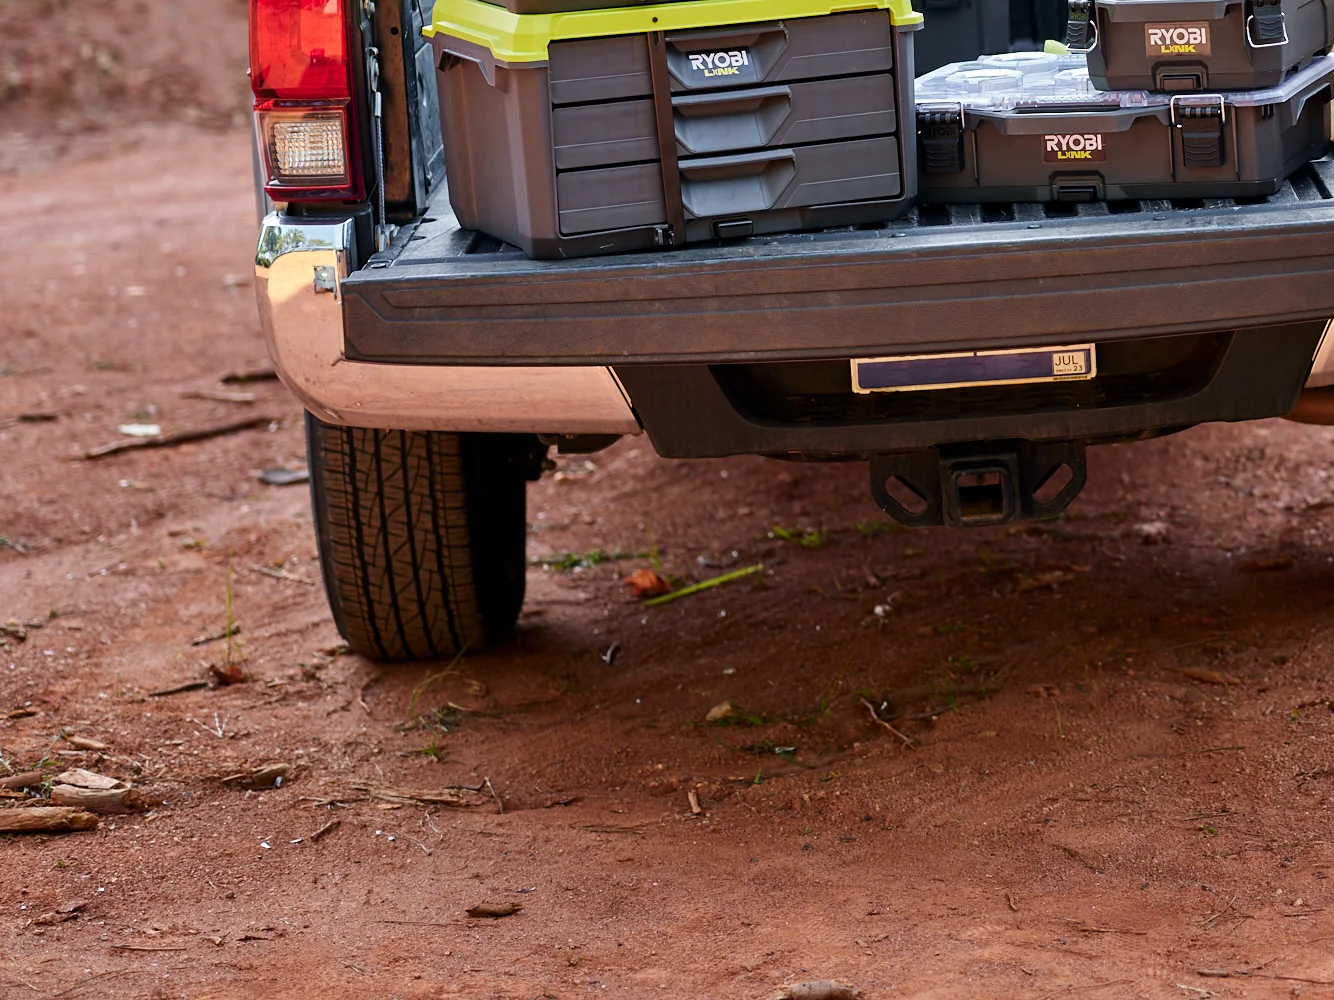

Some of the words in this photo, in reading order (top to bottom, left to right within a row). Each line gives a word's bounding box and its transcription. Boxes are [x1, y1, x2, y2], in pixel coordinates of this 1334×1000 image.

[1148, 27, 1207, 45] RYOBI
[689, 50, 749, 70] RYOBI
[1044, 134, 1102, 151] RYOBI
[1055, 355, 1079, 366] JUL
